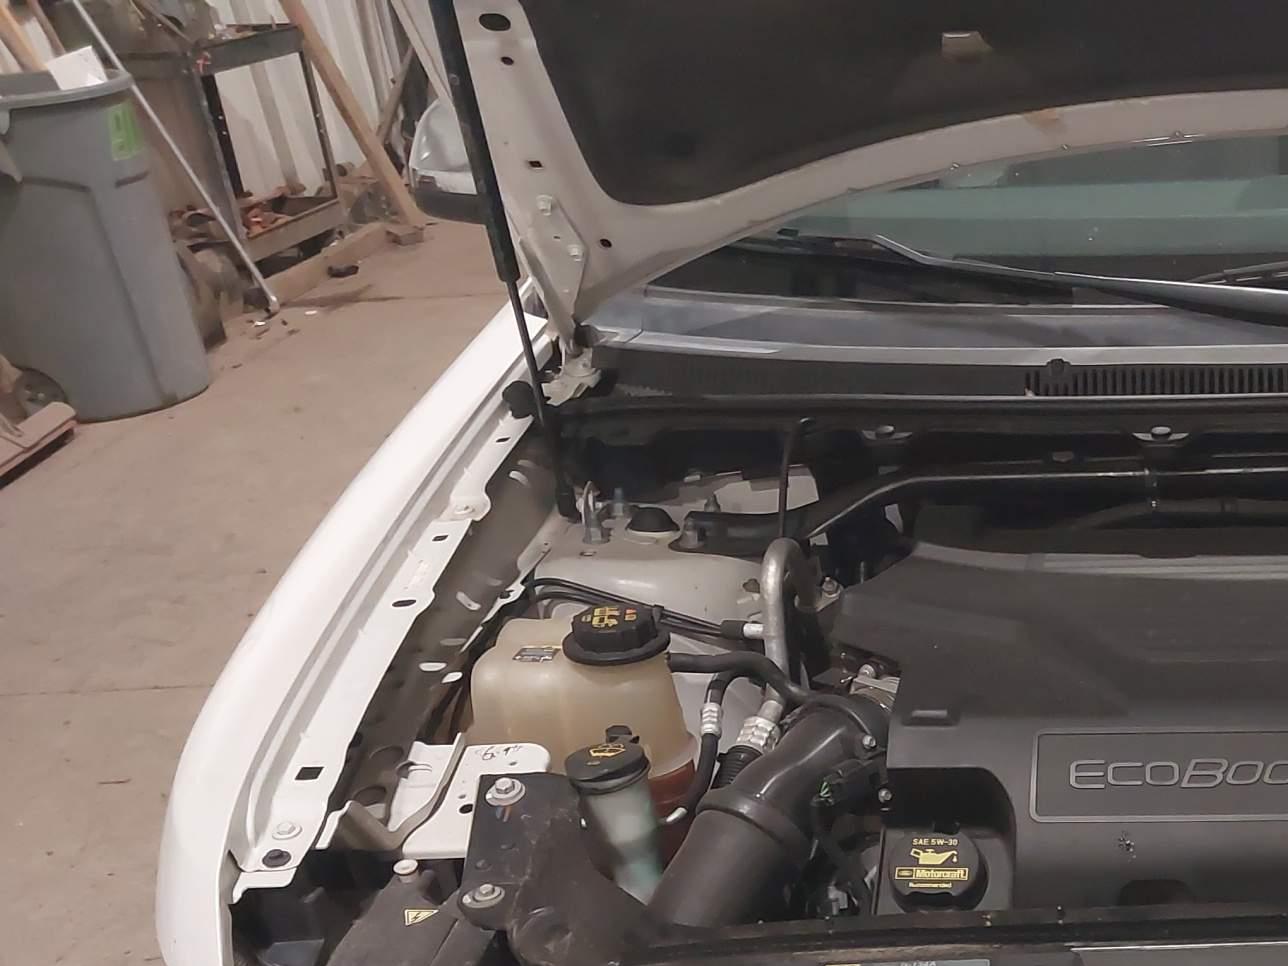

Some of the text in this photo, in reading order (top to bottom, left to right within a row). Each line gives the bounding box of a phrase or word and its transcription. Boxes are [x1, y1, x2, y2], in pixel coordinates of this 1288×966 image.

[912, 838, 959, 846] SAE 5W-30
[915, 869, 966, 879] Motorcraft
